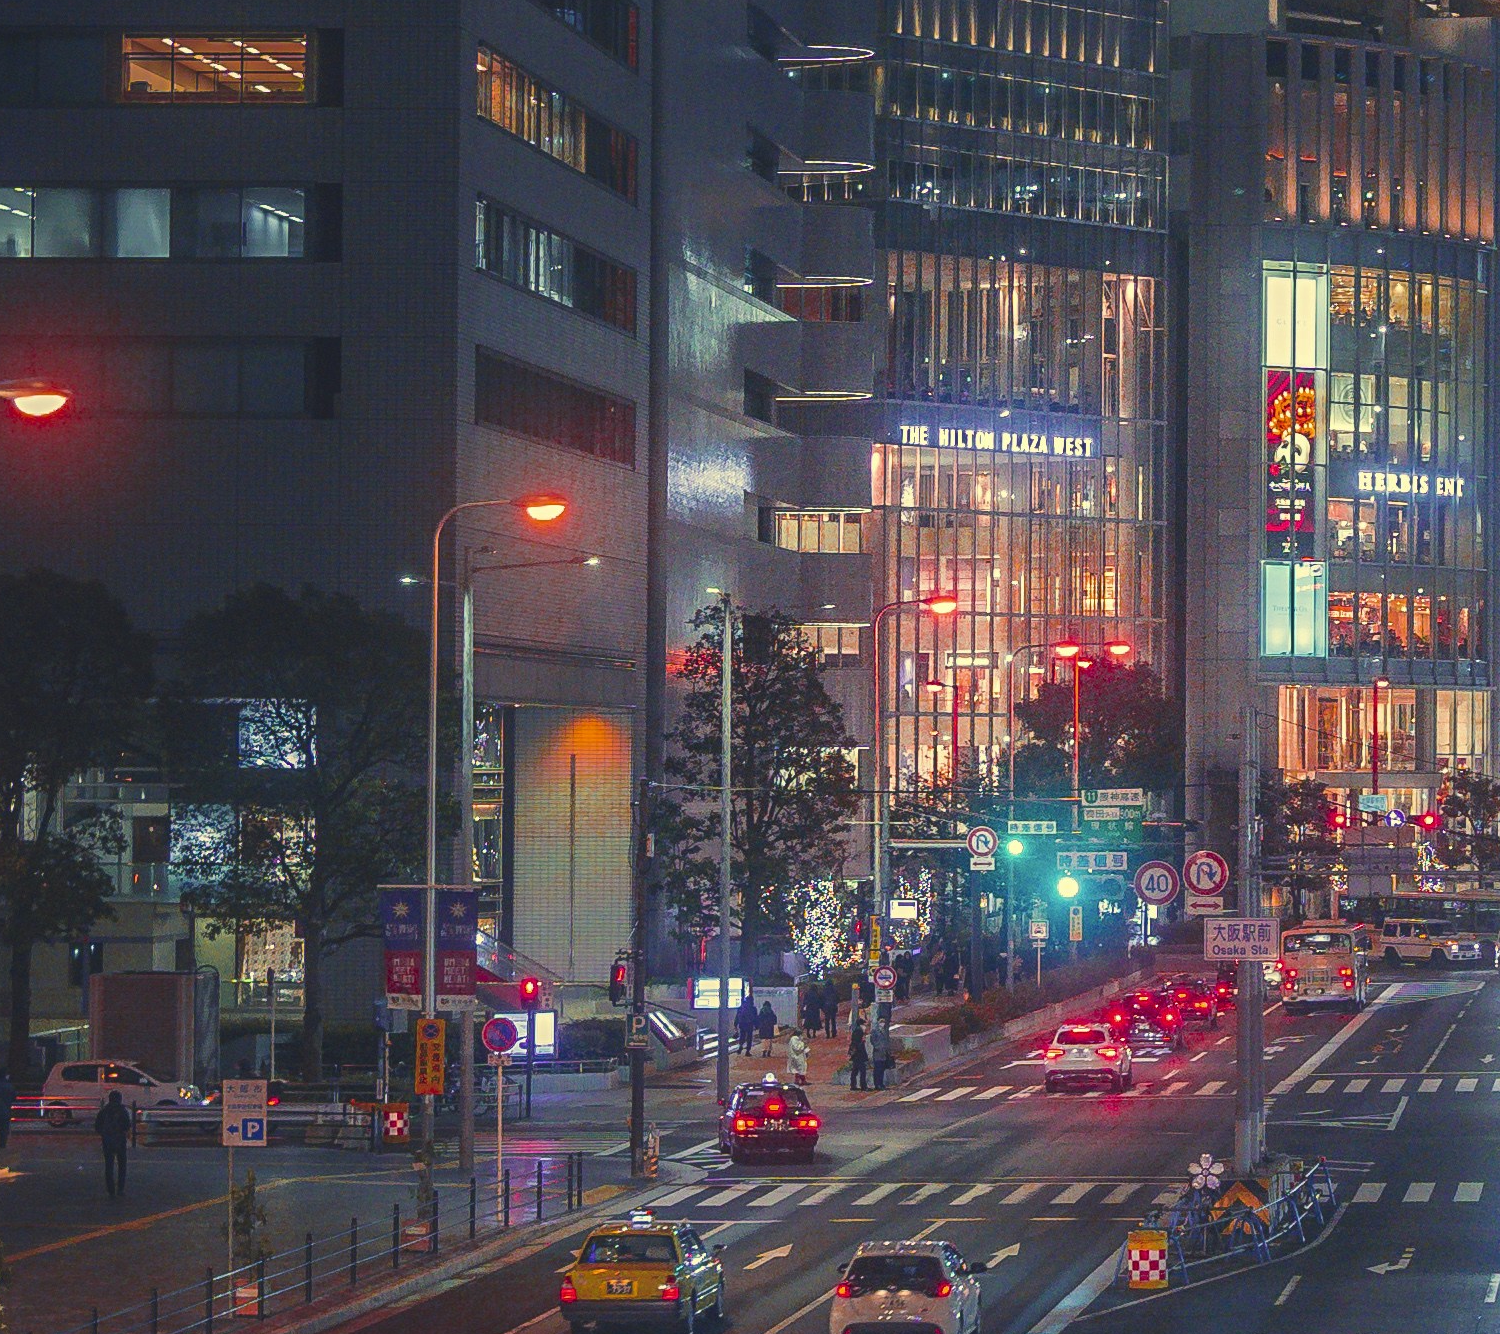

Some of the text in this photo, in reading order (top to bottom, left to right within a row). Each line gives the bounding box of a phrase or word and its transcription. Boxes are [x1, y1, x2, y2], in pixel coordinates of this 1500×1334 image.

[900, 425, 1093, 457] THE HILTON PLAZA WEST
[1358, 471, 1464, 497] HERBIS ENT
[1145, 874, 1169, 893] 40
[1213, 923, 1271, 942] 大阪駅前
[1213, 944, 1271, 955] Osaka Sta.
[632, 1016, 646, 1033] P
[247, 1122, 260, 1138] P
